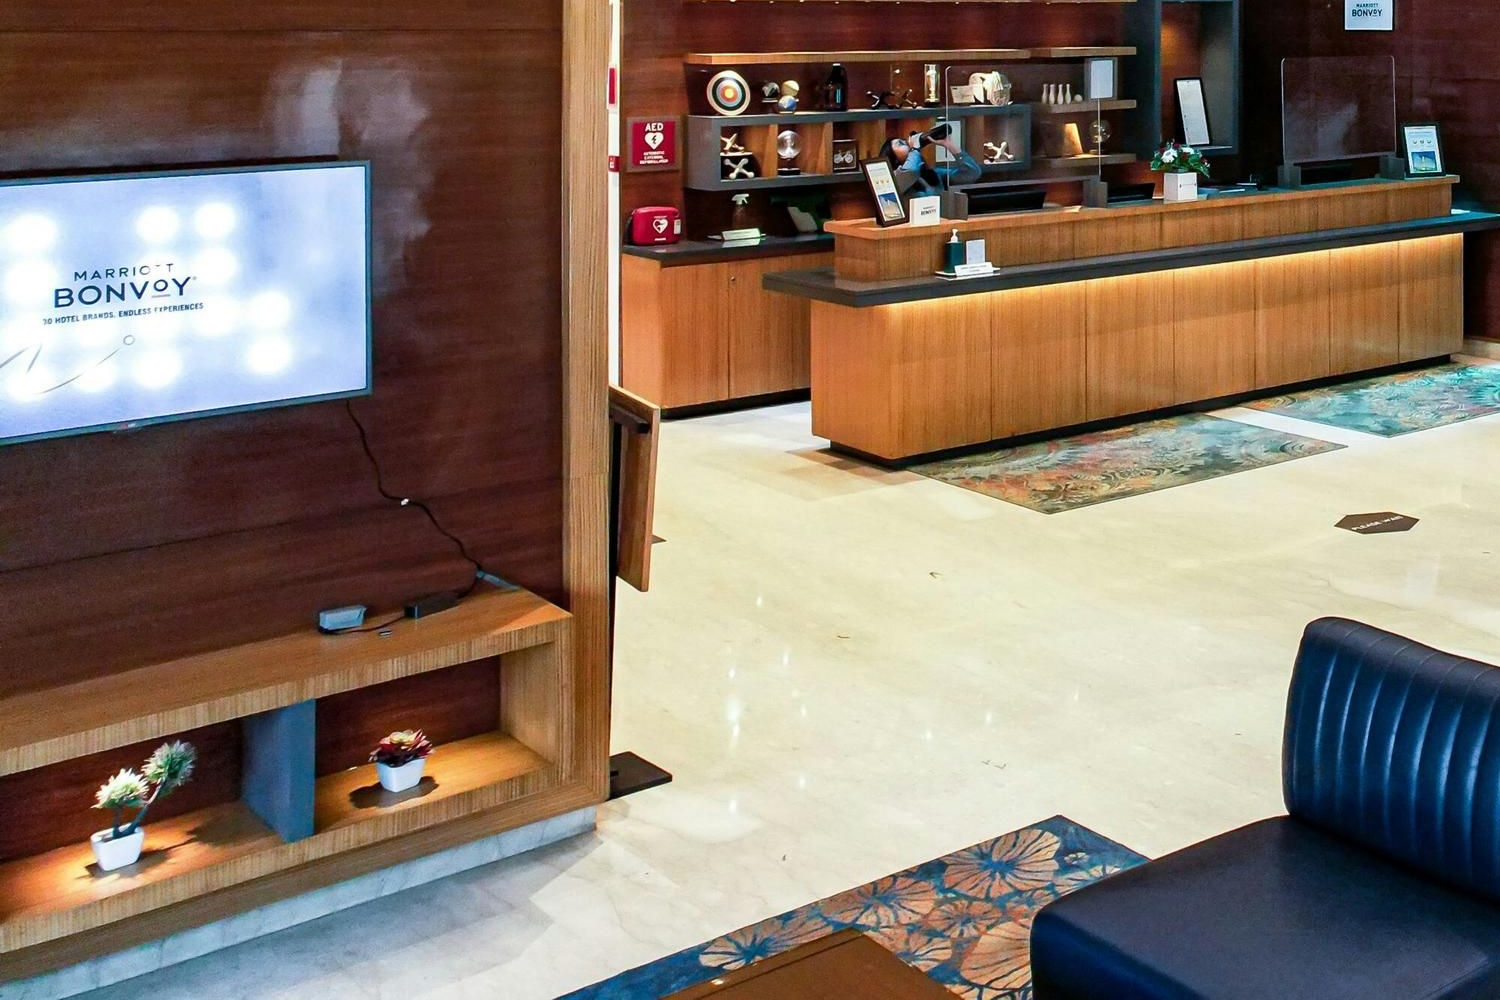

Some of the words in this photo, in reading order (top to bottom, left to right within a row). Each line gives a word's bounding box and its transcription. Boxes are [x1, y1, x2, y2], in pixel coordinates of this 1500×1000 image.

[1352, 8, 1382, 17] BONVOY
[645, 122, 664, 132] AED
[74, 263, 174, 282] MARRIOT
[54, 276, 191, 308] BONVOY
[55, 315, 80, 324] HOTEL
[118, 308, 151, 317] ENDLESS
[154, 302, 204, 312] EXPERIENCES
